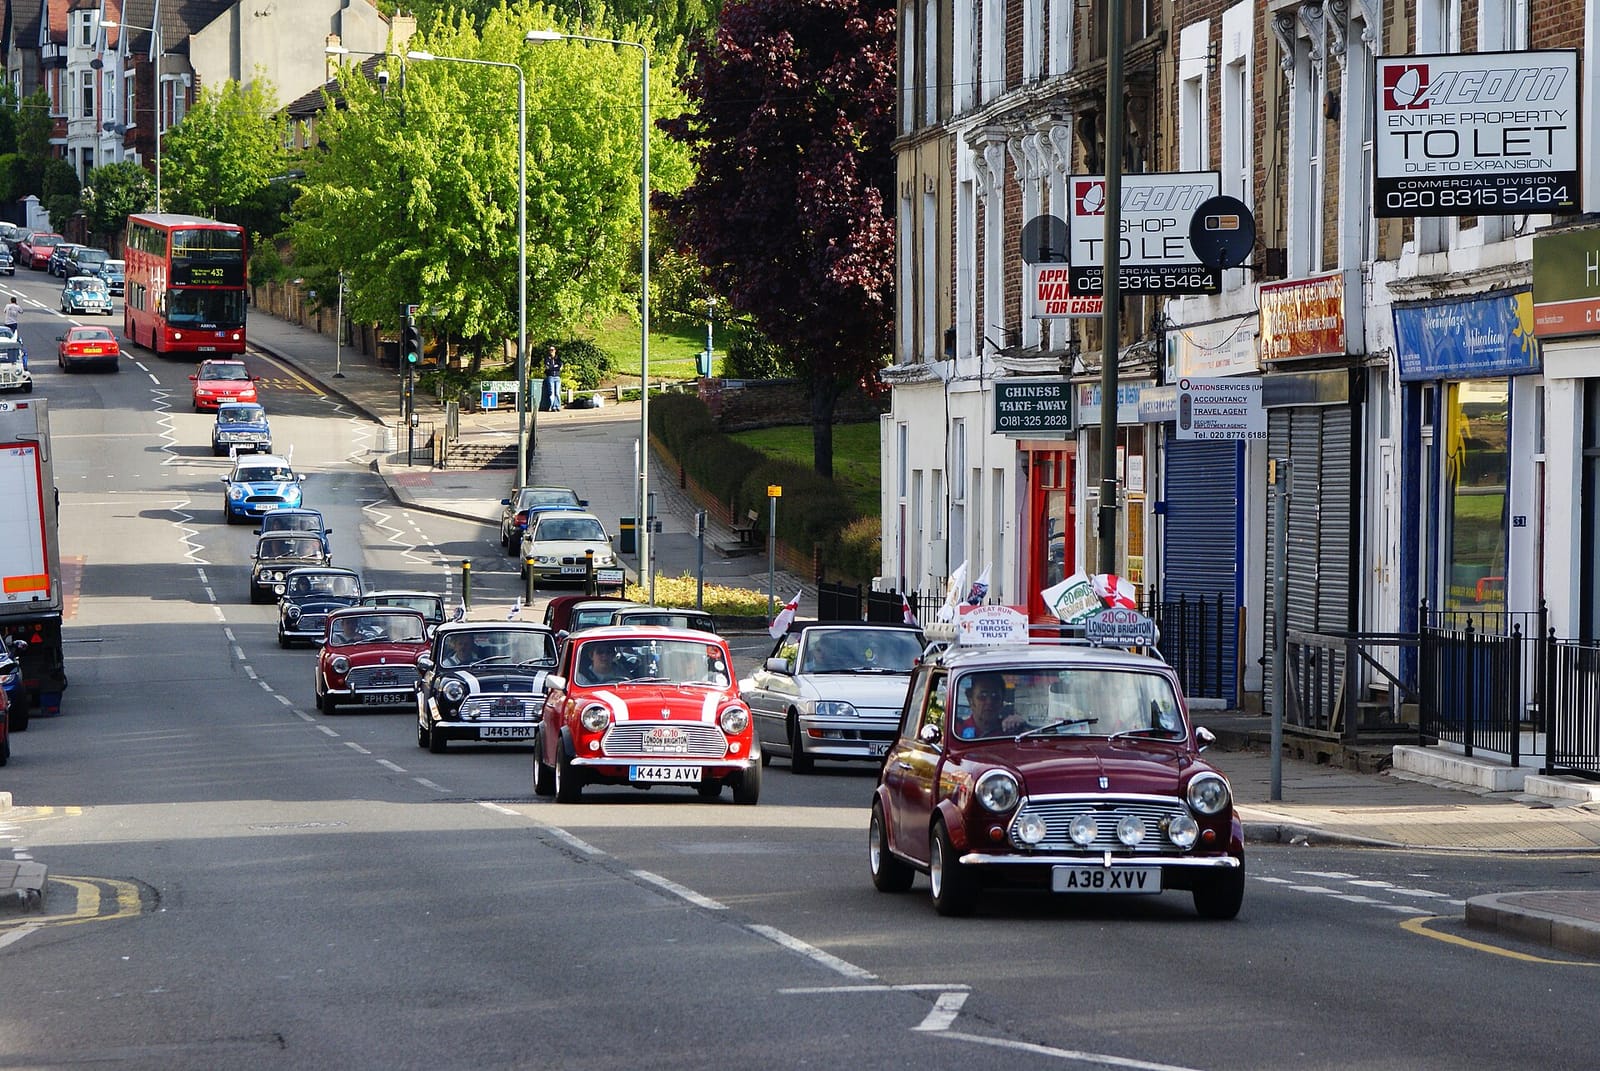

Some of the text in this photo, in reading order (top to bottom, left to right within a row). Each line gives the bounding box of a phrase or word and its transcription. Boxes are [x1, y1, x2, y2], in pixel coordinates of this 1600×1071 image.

[1388, 109, 1568, 127] ENTIRE PROPERTY
[1390, 126, 1567, 160] TO LET
[1405, 159, 1552, 173] DUE TO EXPANSION
[1397, 176, 1557, 189] COMMERCIAL DIVISION
[1386, 186, 1569, 209] 020 8315 5464
[1120, 218, 1177, 233] SHOP
[1142, 236, 1190, 259] LE
[210, 268, 224, 277] 432
[1160, 266, 1206, 275] DIVISION
[1164, 274, 1214, 288] 5464
[1045, 300, 1103, 314] FOR CASH
[1005, 386, 1061, 398] CHINESE
[1000, 400, 1068, 412] TAKE-AWAY
[1000, 415, 1068, 427] 0181-325 2828
[1194, 431, 1267, 439] Tel. 020 8776 6188
[973, 606, 1013, 615] GREAT RUN
[1088, 620, 1152, 635] LONDON BRIGHTON
[485, 728, 531, 736] J445 PRX
[643, 735, 687, 745] LONDON BRIGHTON
[638, 767, 699, 779] K443 AVV
[1067, 870, 1147, 889] A38 XVV
